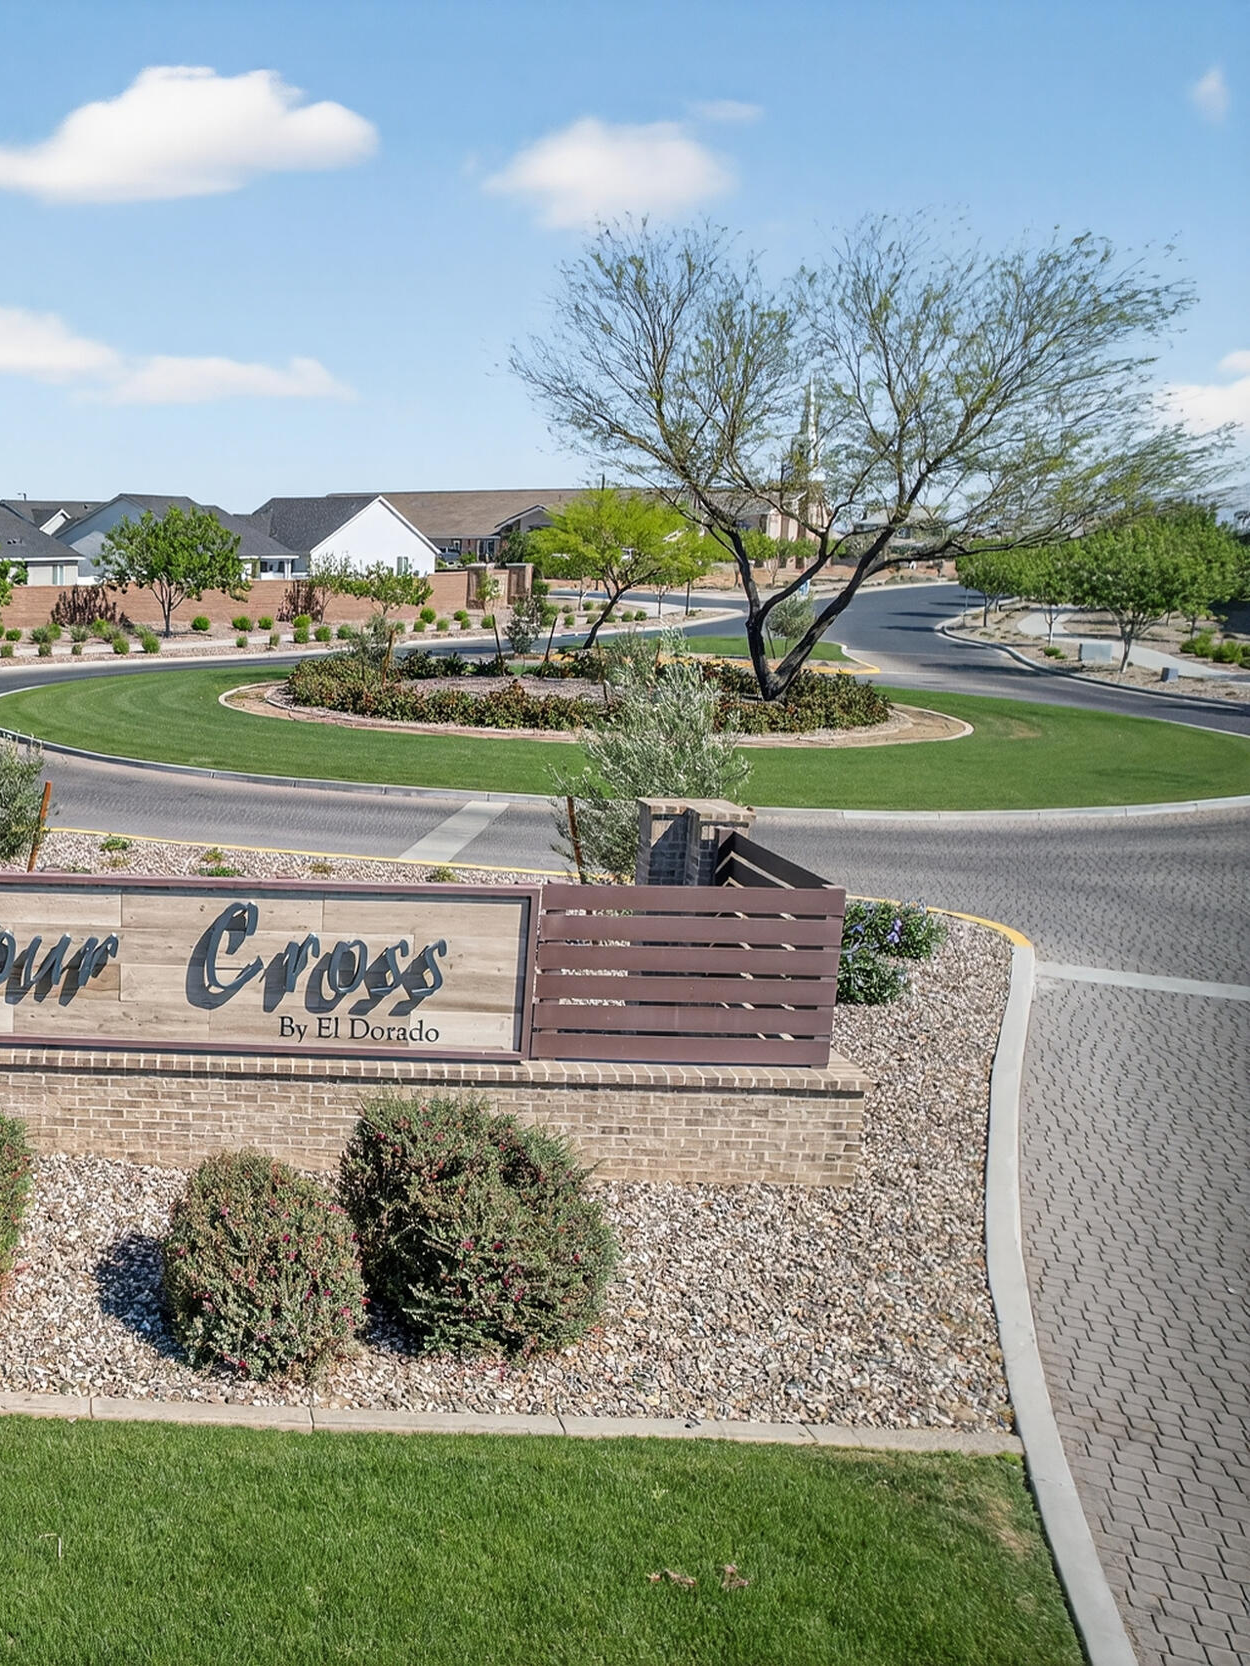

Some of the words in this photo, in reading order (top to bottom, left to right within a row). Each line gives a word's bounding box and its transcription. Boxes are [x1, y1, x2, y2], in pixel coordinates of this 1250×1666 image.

[196, 901, 448, 1003] Cross
[279, 1016, 307, 1043] By
[317, 1017, 339, 1039] El
[349, 1018, 440, 1043] Dorado
